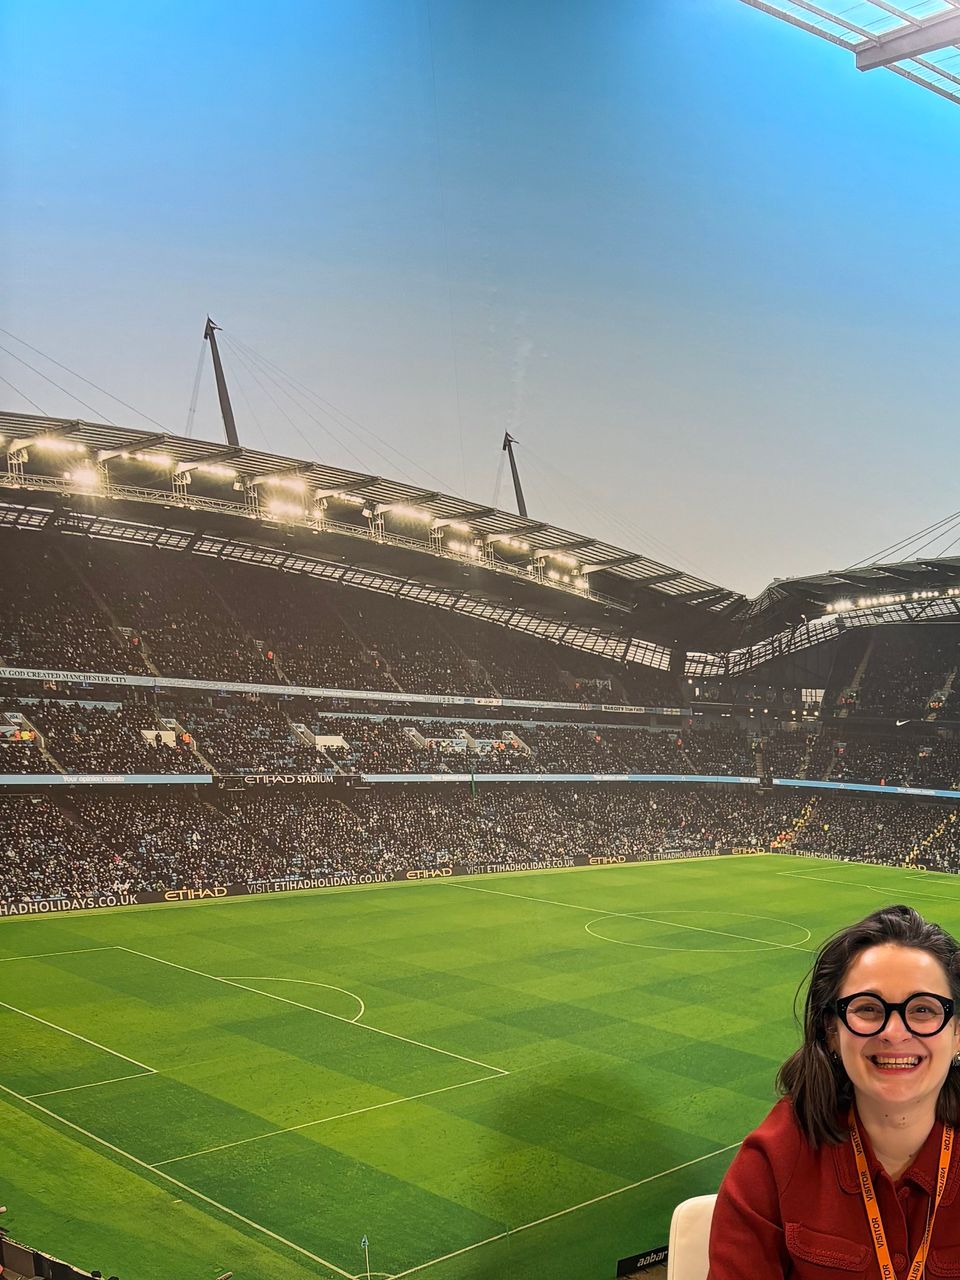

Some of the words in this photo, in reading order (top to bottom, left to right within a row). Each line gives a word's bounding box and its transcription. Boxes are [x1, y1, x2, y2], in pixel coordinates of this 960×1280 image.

[27, 671, 60, 679] CREATED
[62, 673, 110, 681] MANCHESTER
[244, 775, 296, 784] ETIHAD
[297, 775, 335, 784] STADIUM
[732, 847, 766, 855] ETIHAD
[589, 855, 627, 865] ETIHAD
[466, 866, 485, 875] VISIT
[487, 859, 575, 873] ETIHADHOLIDAYS.CO.UK
[406, 868, 453, 880] ETIHAD
[274, 873, 388, 892] ETIHADHOLIDAYS.CO.UK
[164, 887, 228, 900] ETIHAD
[861, 1170, 874, 1202] VISITOR
[872, 1216, 885, 1249] VISITOR
